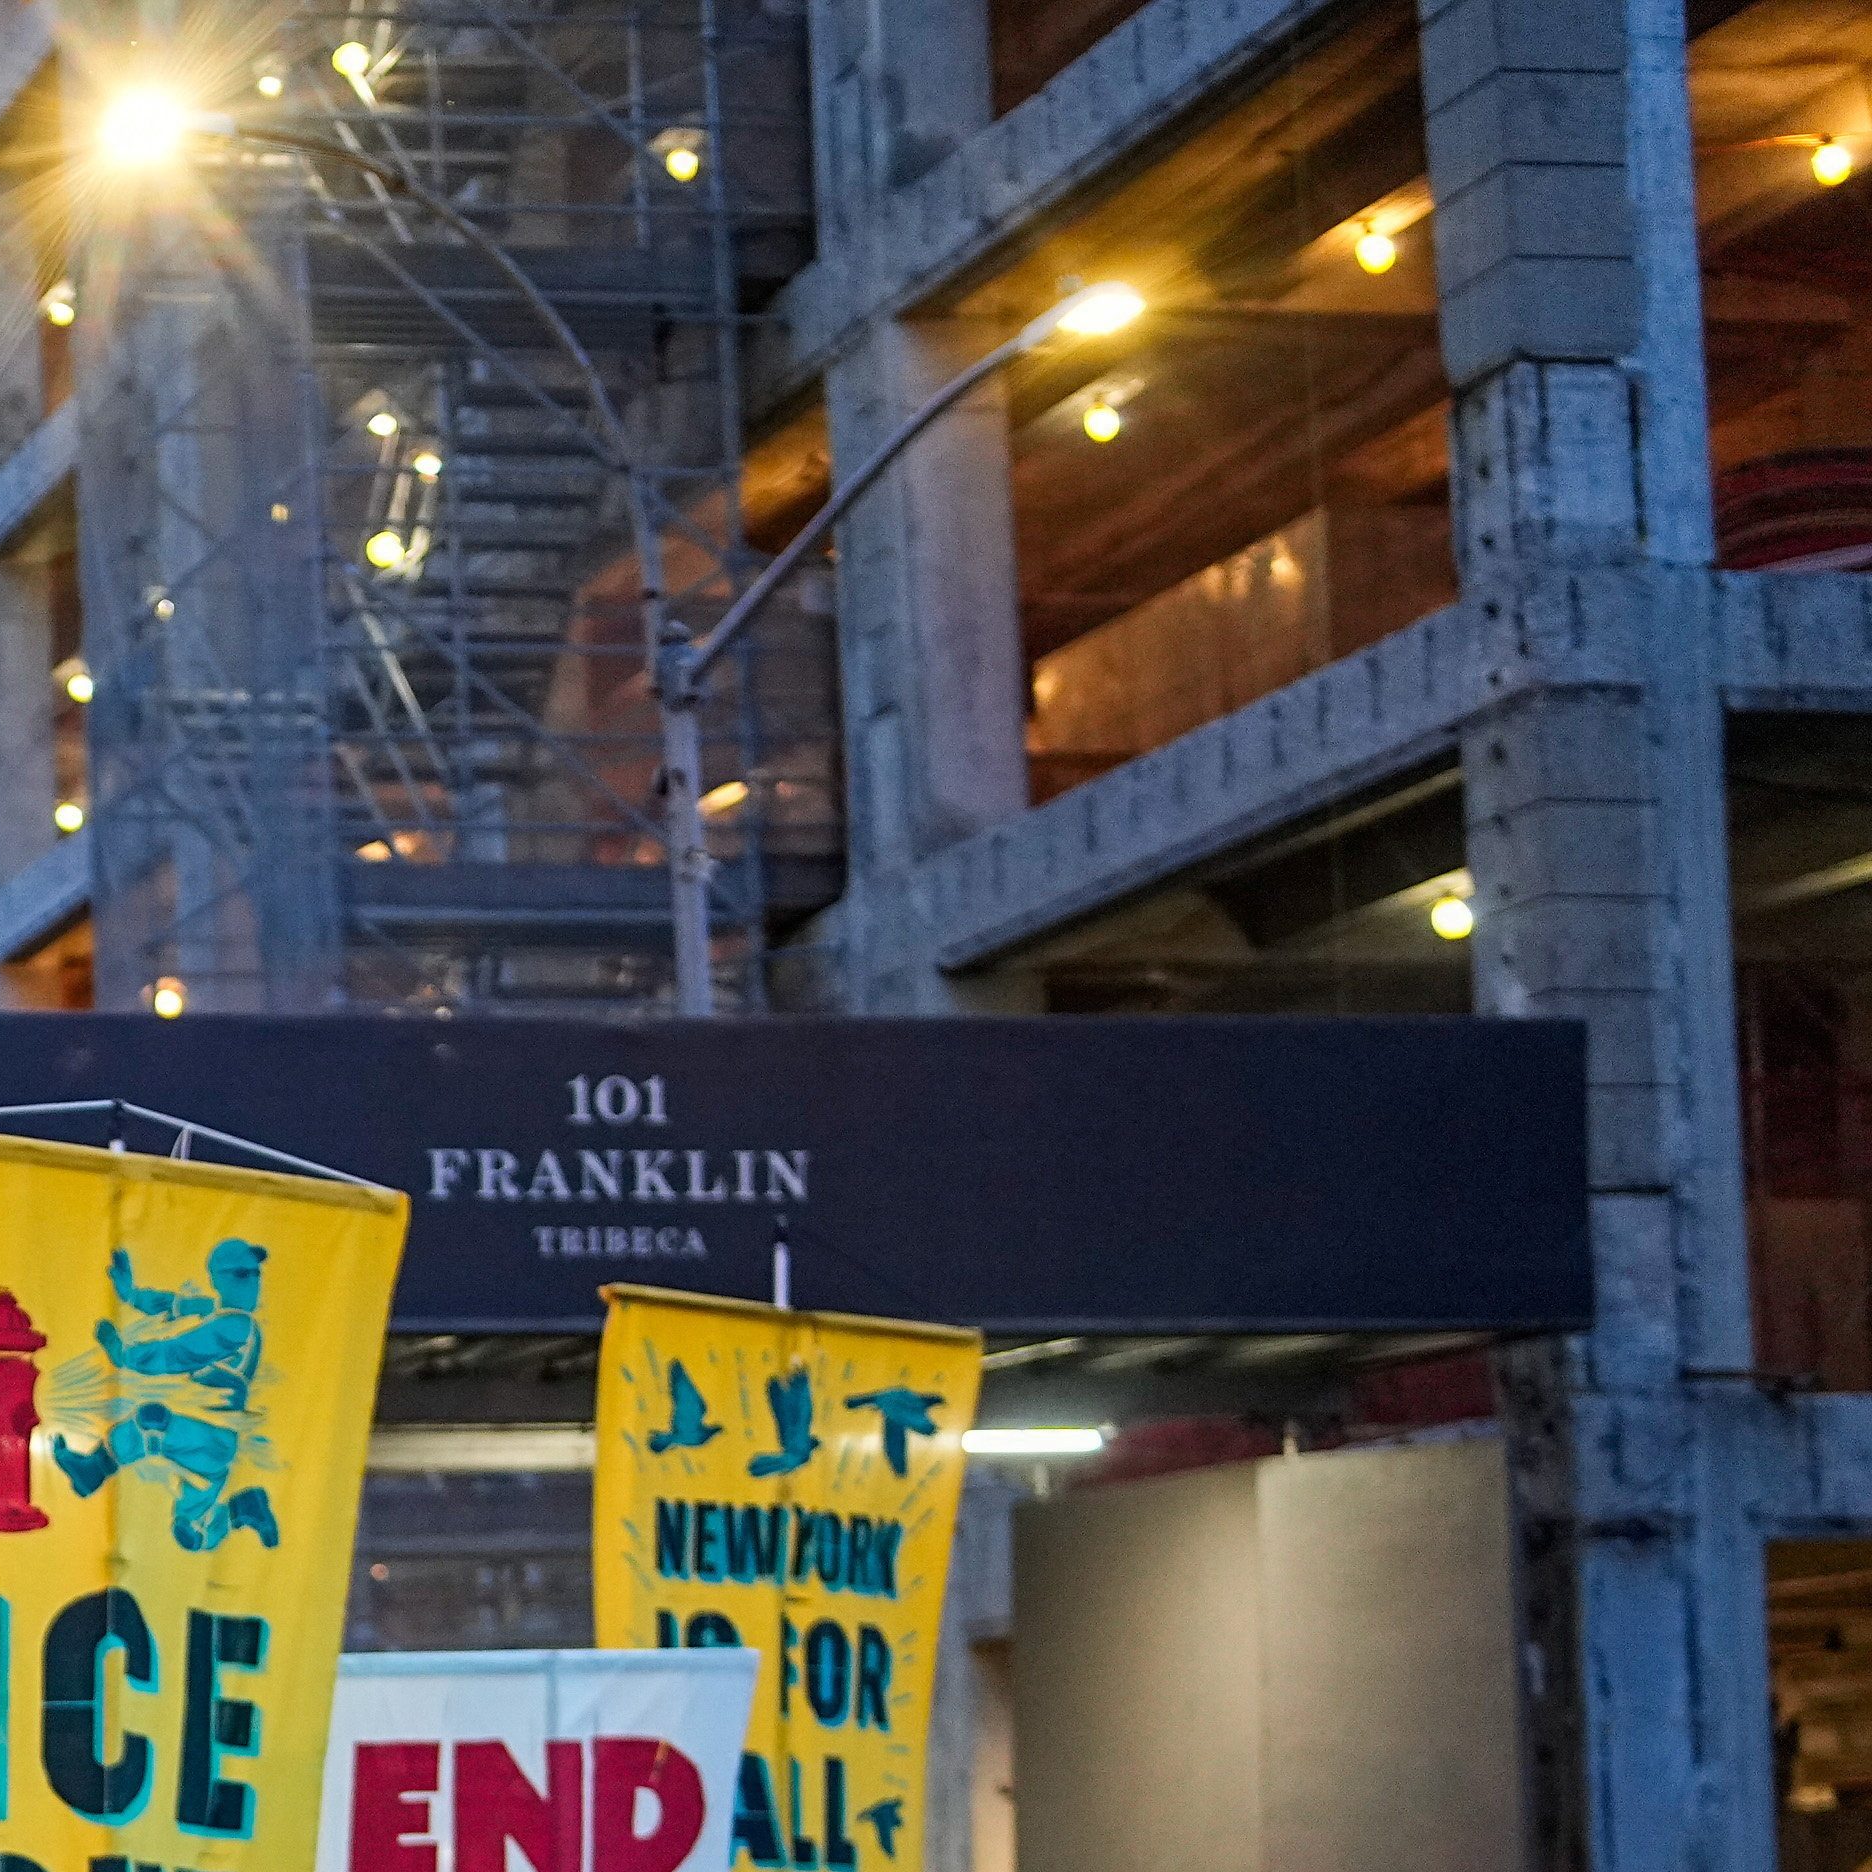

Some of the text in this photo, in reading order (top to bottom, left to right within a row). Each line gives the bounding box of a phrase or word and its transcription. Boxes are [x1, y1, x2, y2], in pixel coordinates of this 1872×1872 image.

[564, 1073, 670, 1125] 101
[426, 1146, 814, 1201] FRANKLIN
[531, 1225, 709, 1260] TRIBECA
[655, 1497, 904, 1603] NEW YORK
[782, 1619, 893, 1731] FOR
